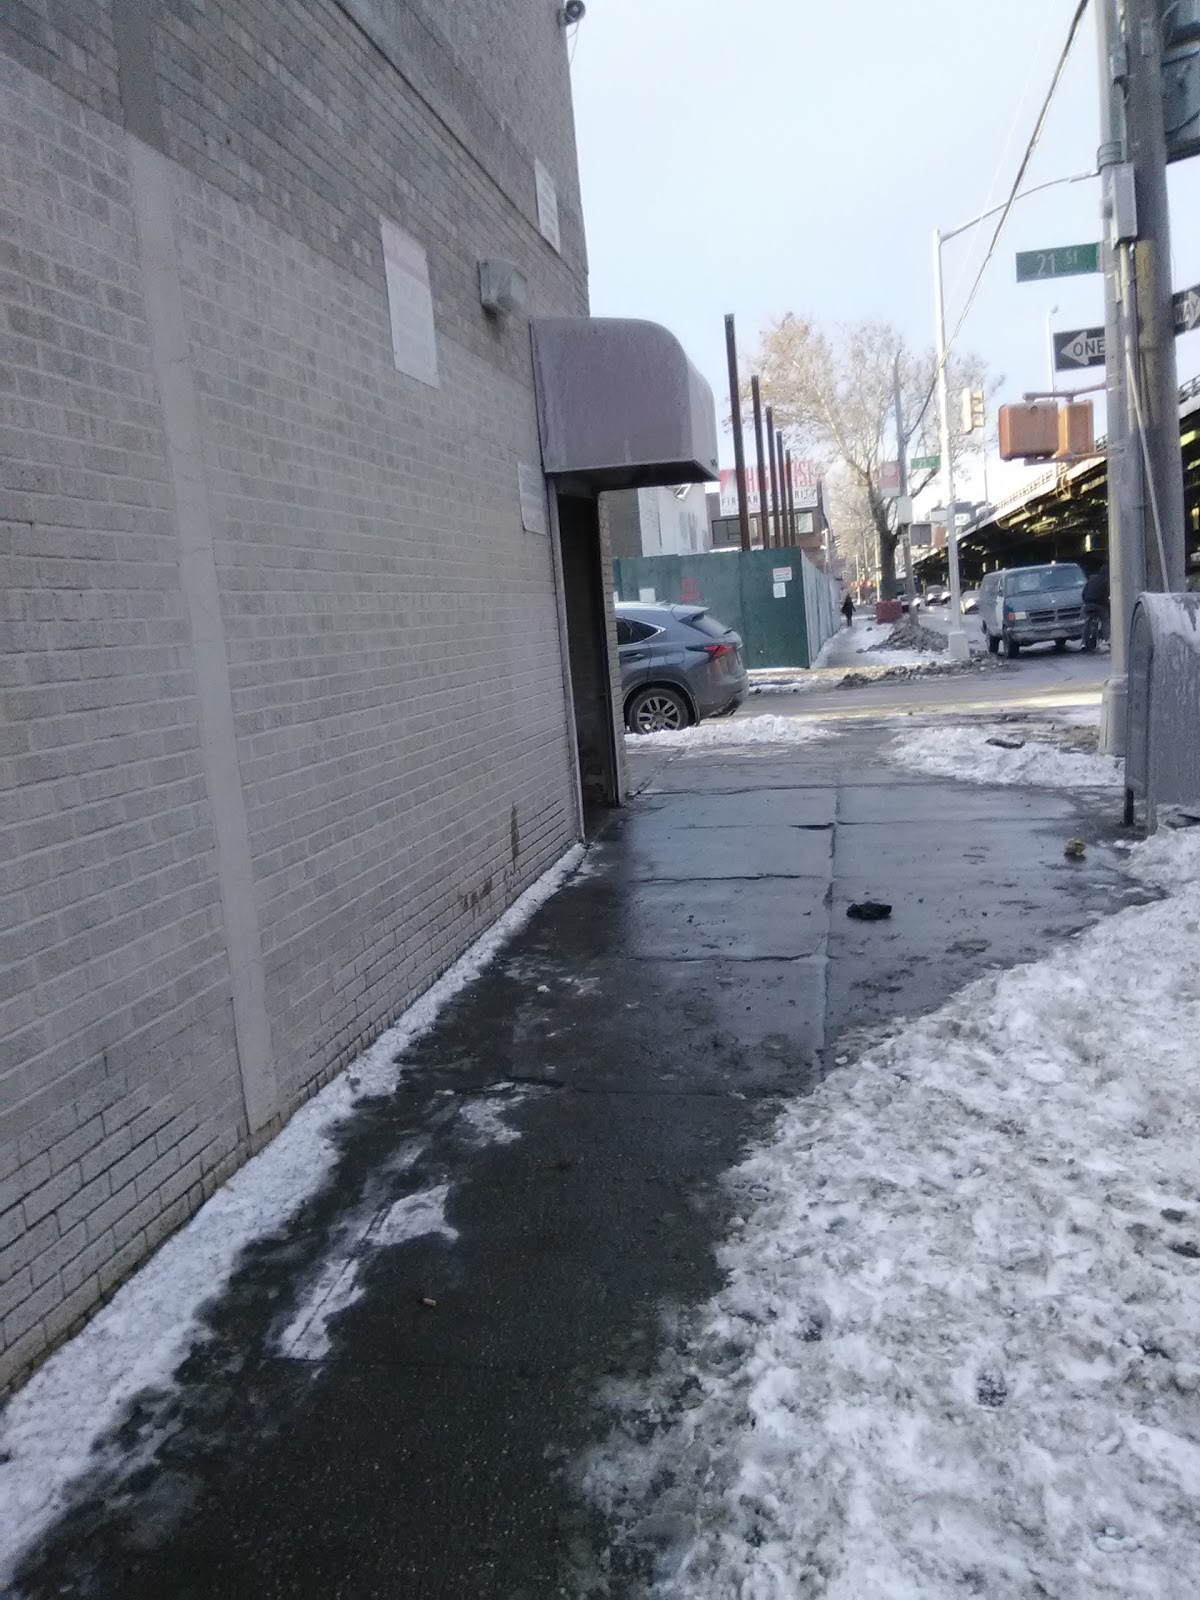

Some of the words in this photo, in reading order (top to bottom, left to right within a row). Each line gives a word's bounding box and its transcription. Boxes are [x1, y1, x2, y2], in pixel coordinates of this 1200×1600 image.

[1036, 253, 1056, 276] 21
[1073, 338, 1105, 356] ONE
[721, 497, 737, 507] FIR
[747, 495, 760, 503] AN
